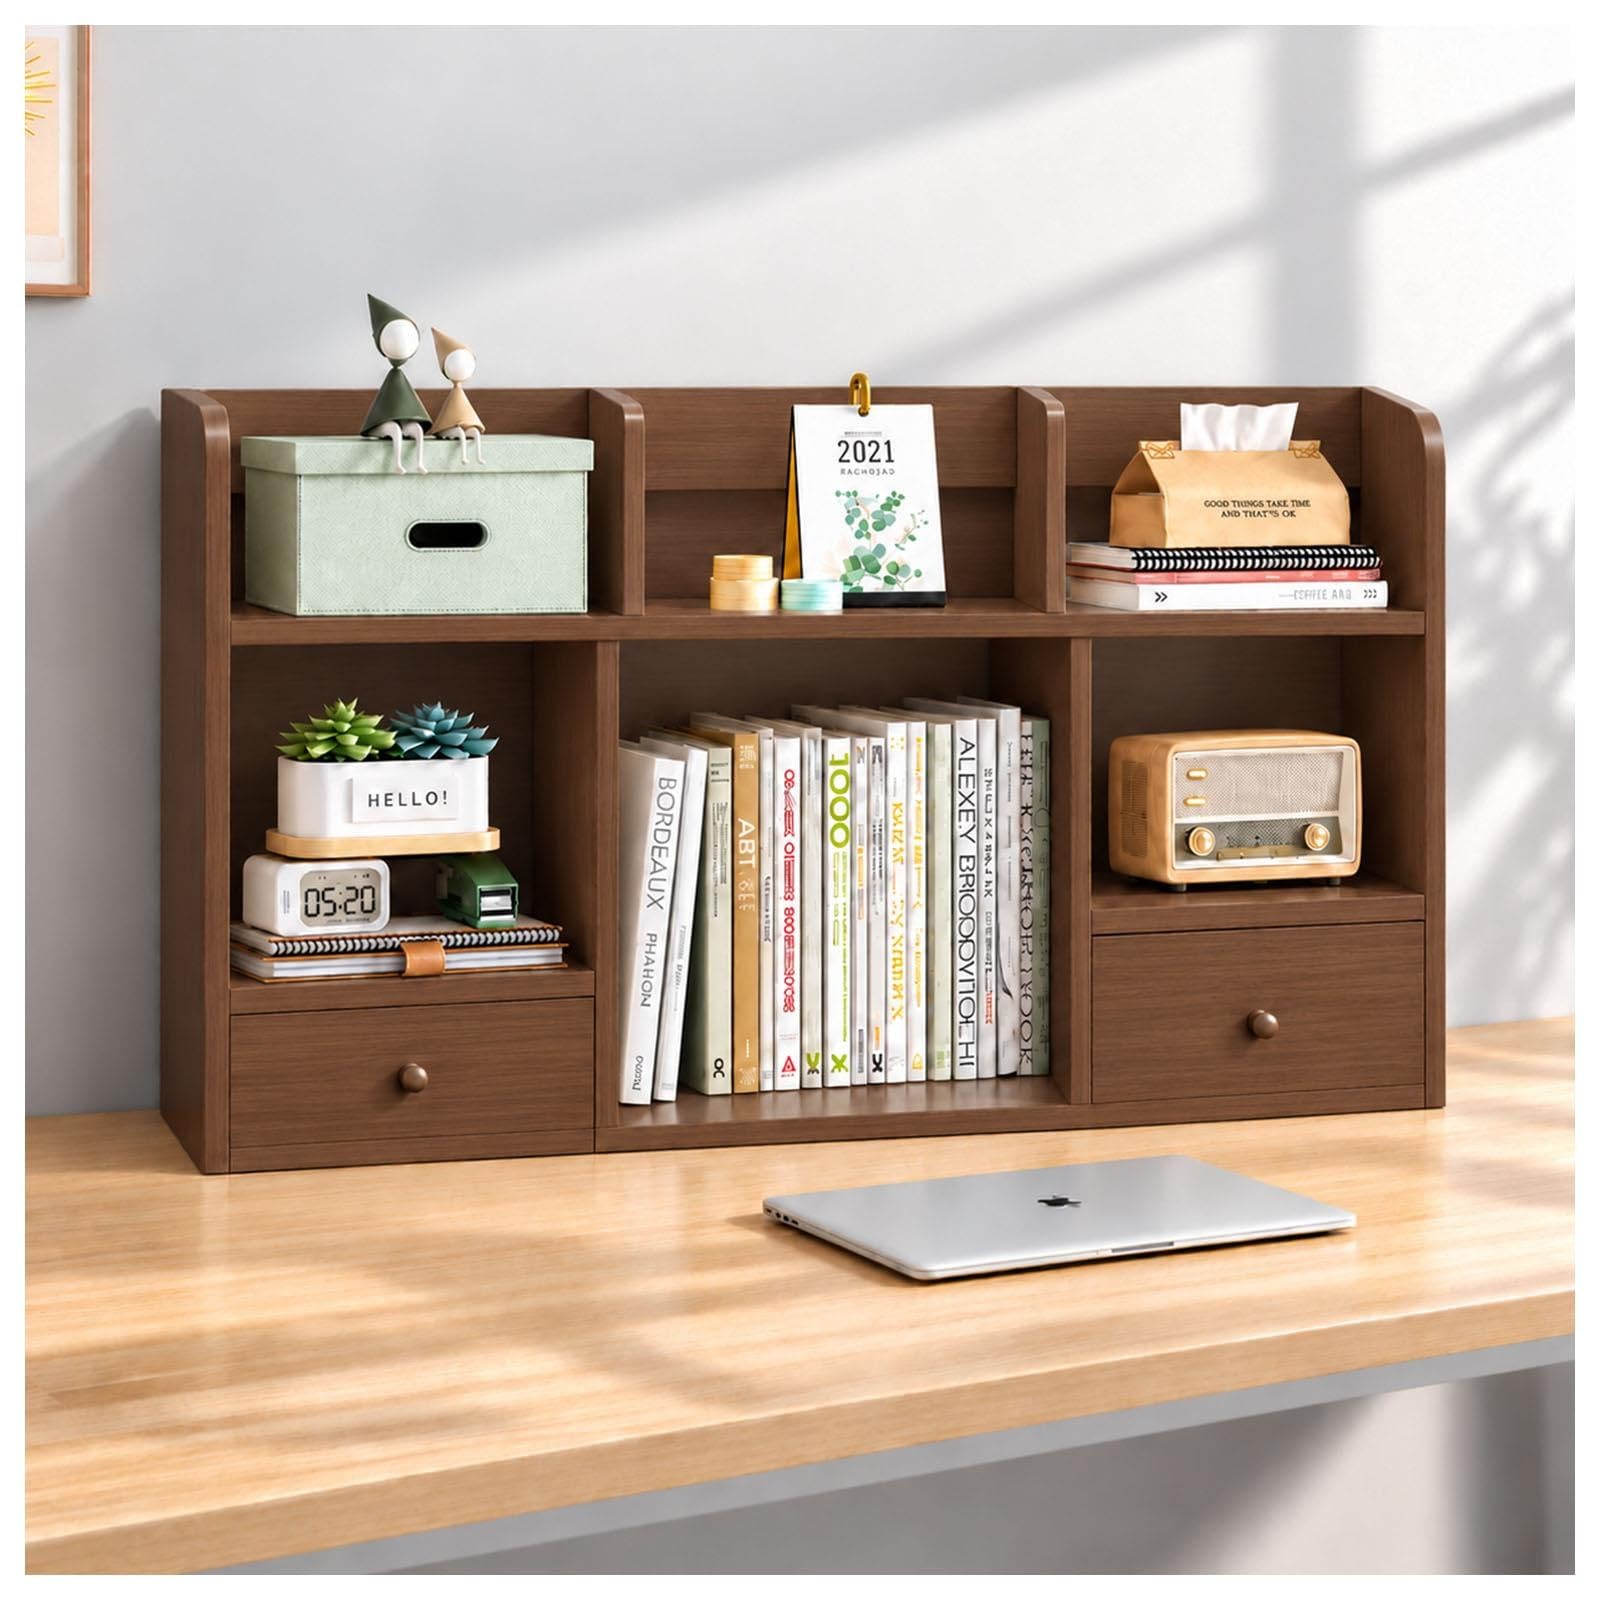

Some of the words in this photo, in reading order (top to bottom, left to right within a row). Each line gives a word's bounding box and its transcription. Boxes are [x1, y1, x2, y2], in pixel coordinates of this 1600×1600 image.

[837, 440, 895, 463] 2021
[1204, 499, 1229, 508] GOOD
[1231, 499, 1264, 508] THINGS
[1266, 499, 1289, 508] TAKE
[1290, 499, 1312, 508] TIME
[1221, 510, 1241, 518] AND
[1282, 510, 1297, 518] OK
[368, 790, 448, 808] HELLO!
[829, 753, 850, 848] 1000
[958, 737, 976, 844] ALEXEY
[646, 777, 677, 910] BORDEAUX
[738, 818, 756, 868] ABT
[304, 885, 376, 917] 05:20
